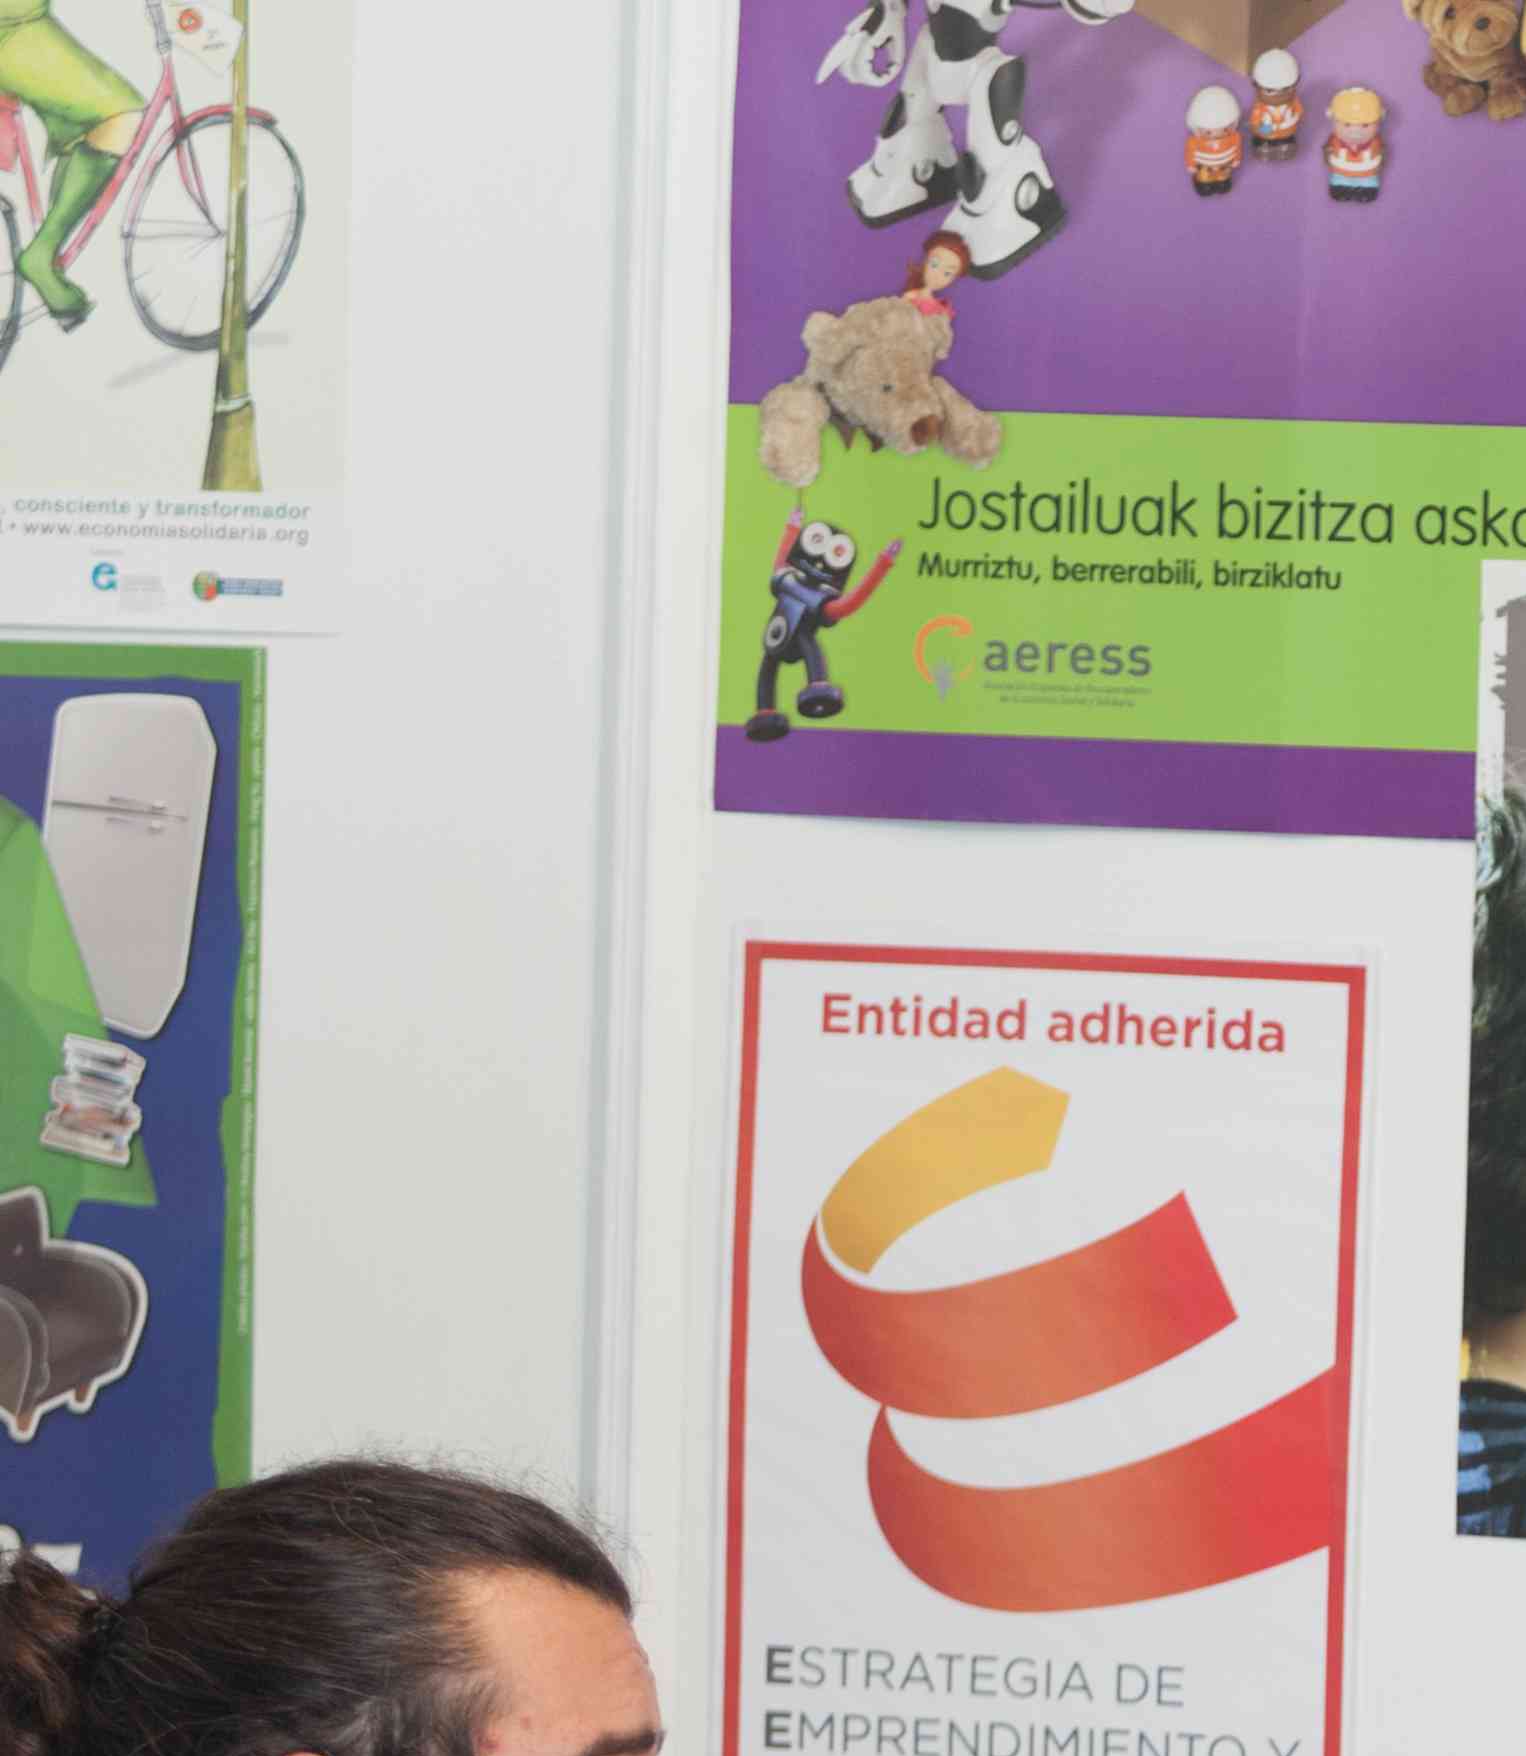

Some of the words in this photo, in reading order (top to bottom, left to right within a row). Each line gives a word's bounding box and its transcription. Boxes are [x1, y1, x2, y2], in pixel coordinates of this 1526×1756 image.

[14, 498, 130, 514] consciente
[138, 504, 150, 518] y
[156, 499, 310, 519] transformador
[918, 477, 1197, 542] Jostailuak
[1217, 481, 1394, 544] bizitza
[918, 551, 1041, 587] Murriztu,
[1050, 554, 1201, 590] berrerabili,
[1212, 557, 1342, 592] birziklatu
[984, 639, 1153, 677] aeress
[822, 993, 1026, 1041] Entidad
[1047, 1002, 1287, 1053] adherida
[765, 1645, 1093, 1704] ESTRATEGIA
[1116, 1664, 1184, 1707] DE
